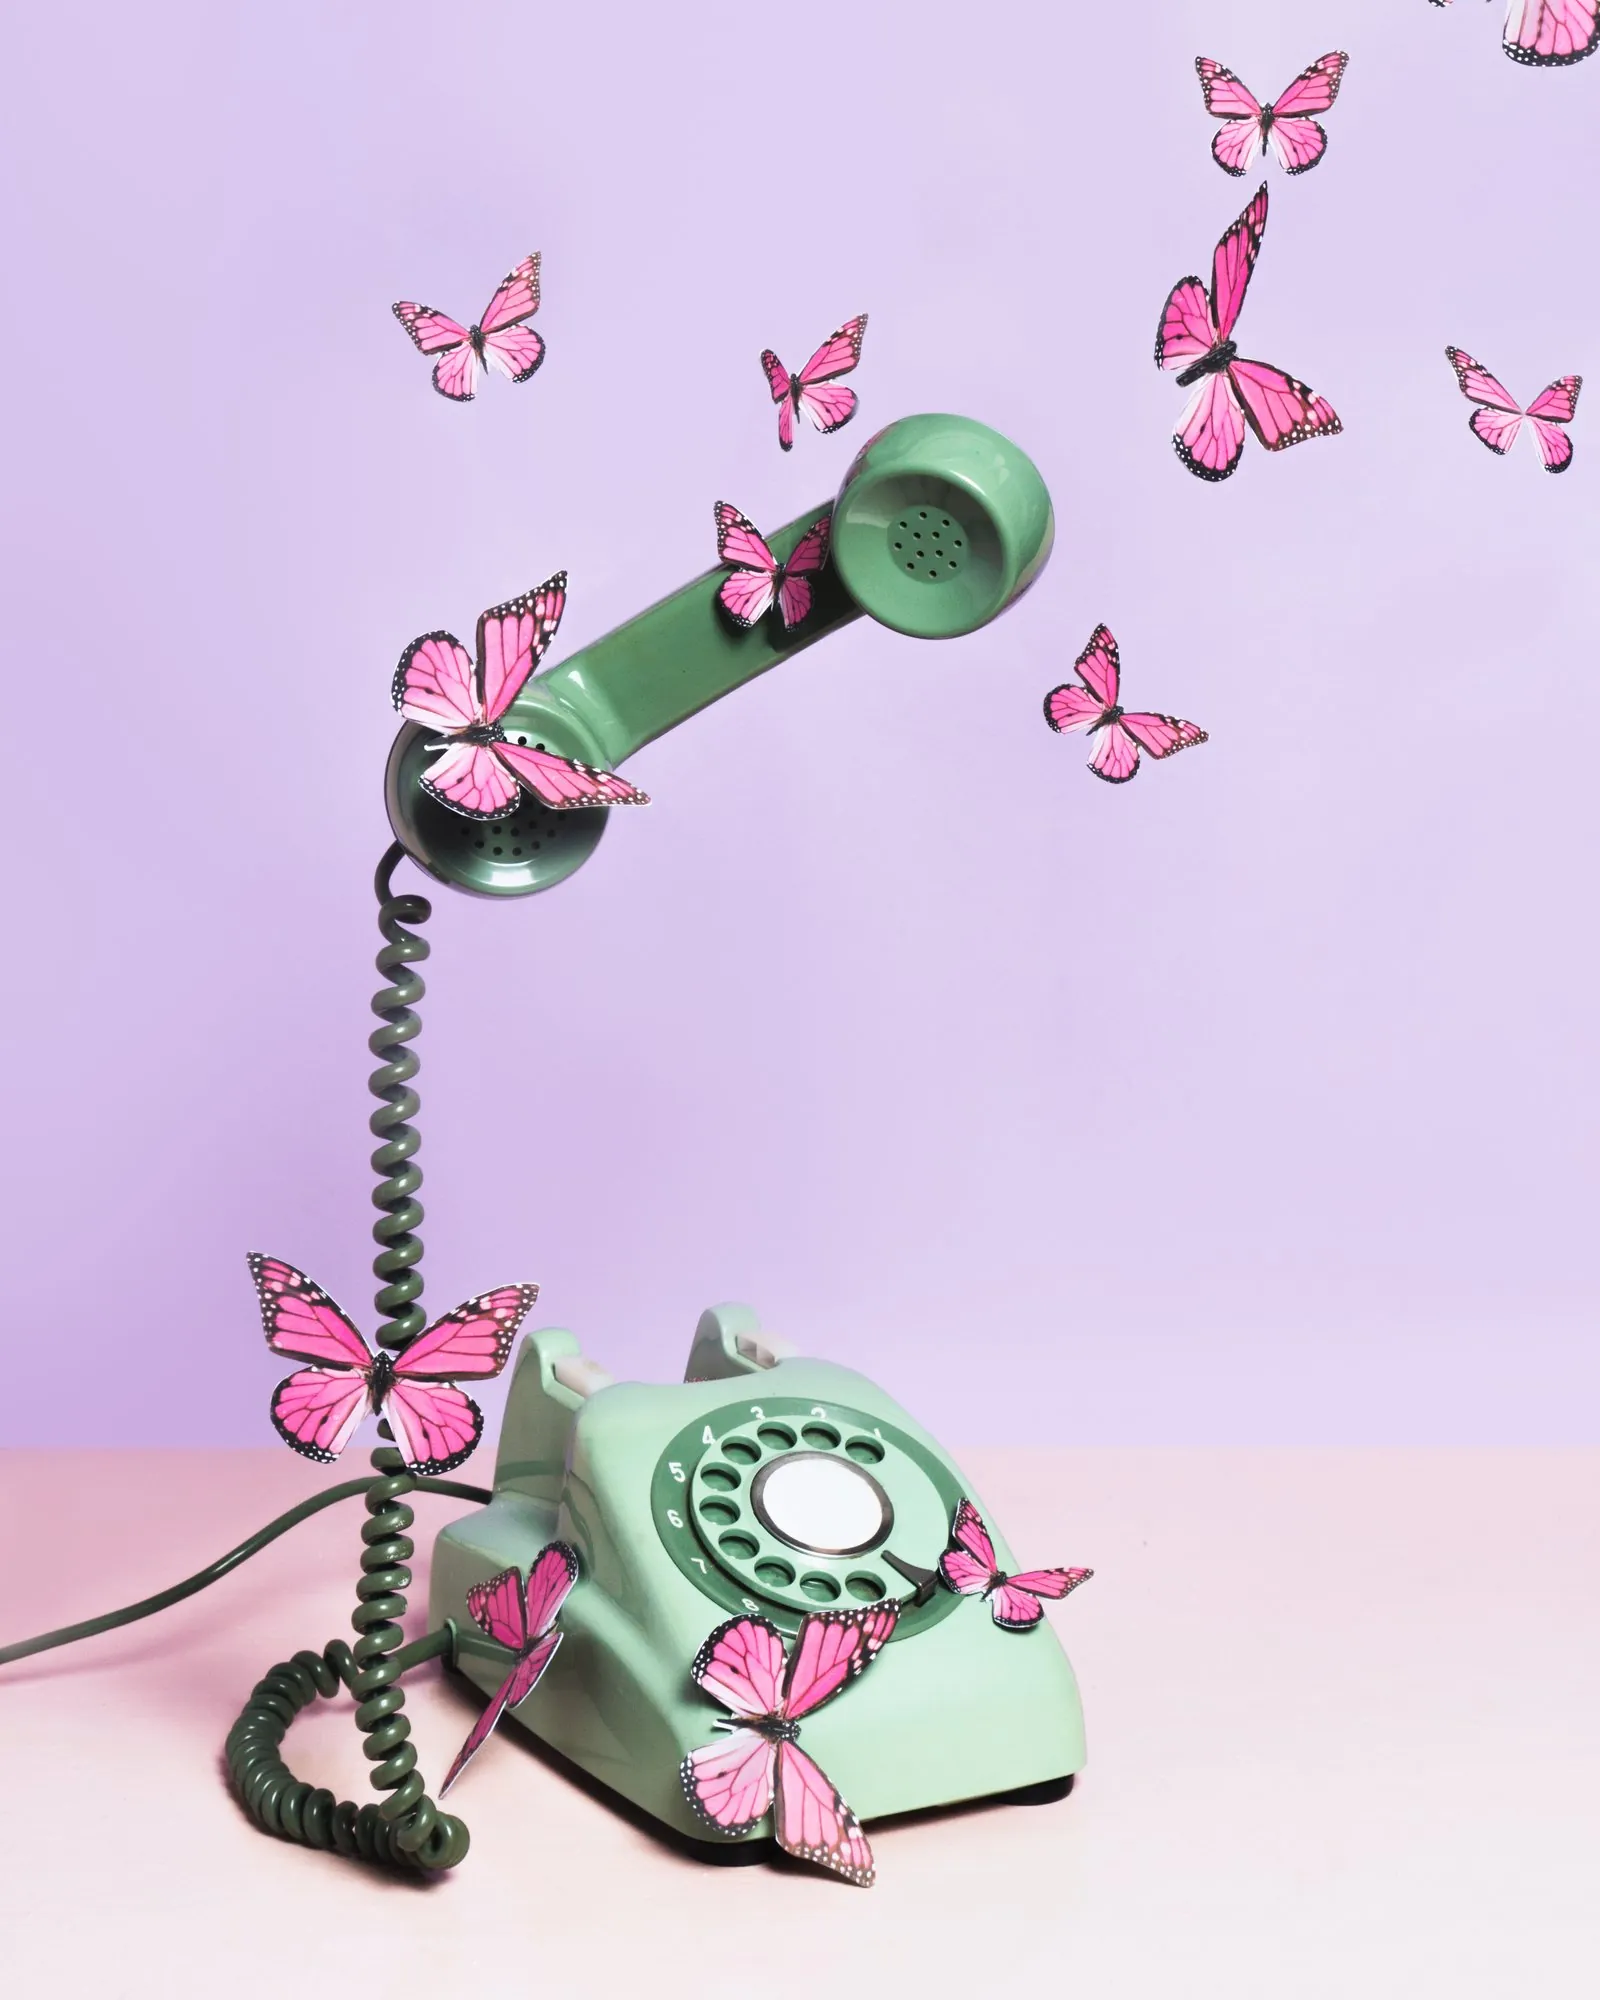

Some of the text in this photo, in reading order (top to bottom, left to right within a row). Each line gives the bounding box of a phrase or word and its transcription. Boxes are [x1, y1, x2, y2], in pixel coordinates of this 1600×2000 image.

[702, 1425, 716, 1445] 4
[668, 1462, 686, 1483] 5
[667, 1510, 684, 1529] 6
[690, 1557, 708, 1574] 7
[741, 1598, 760, 1612] 8
